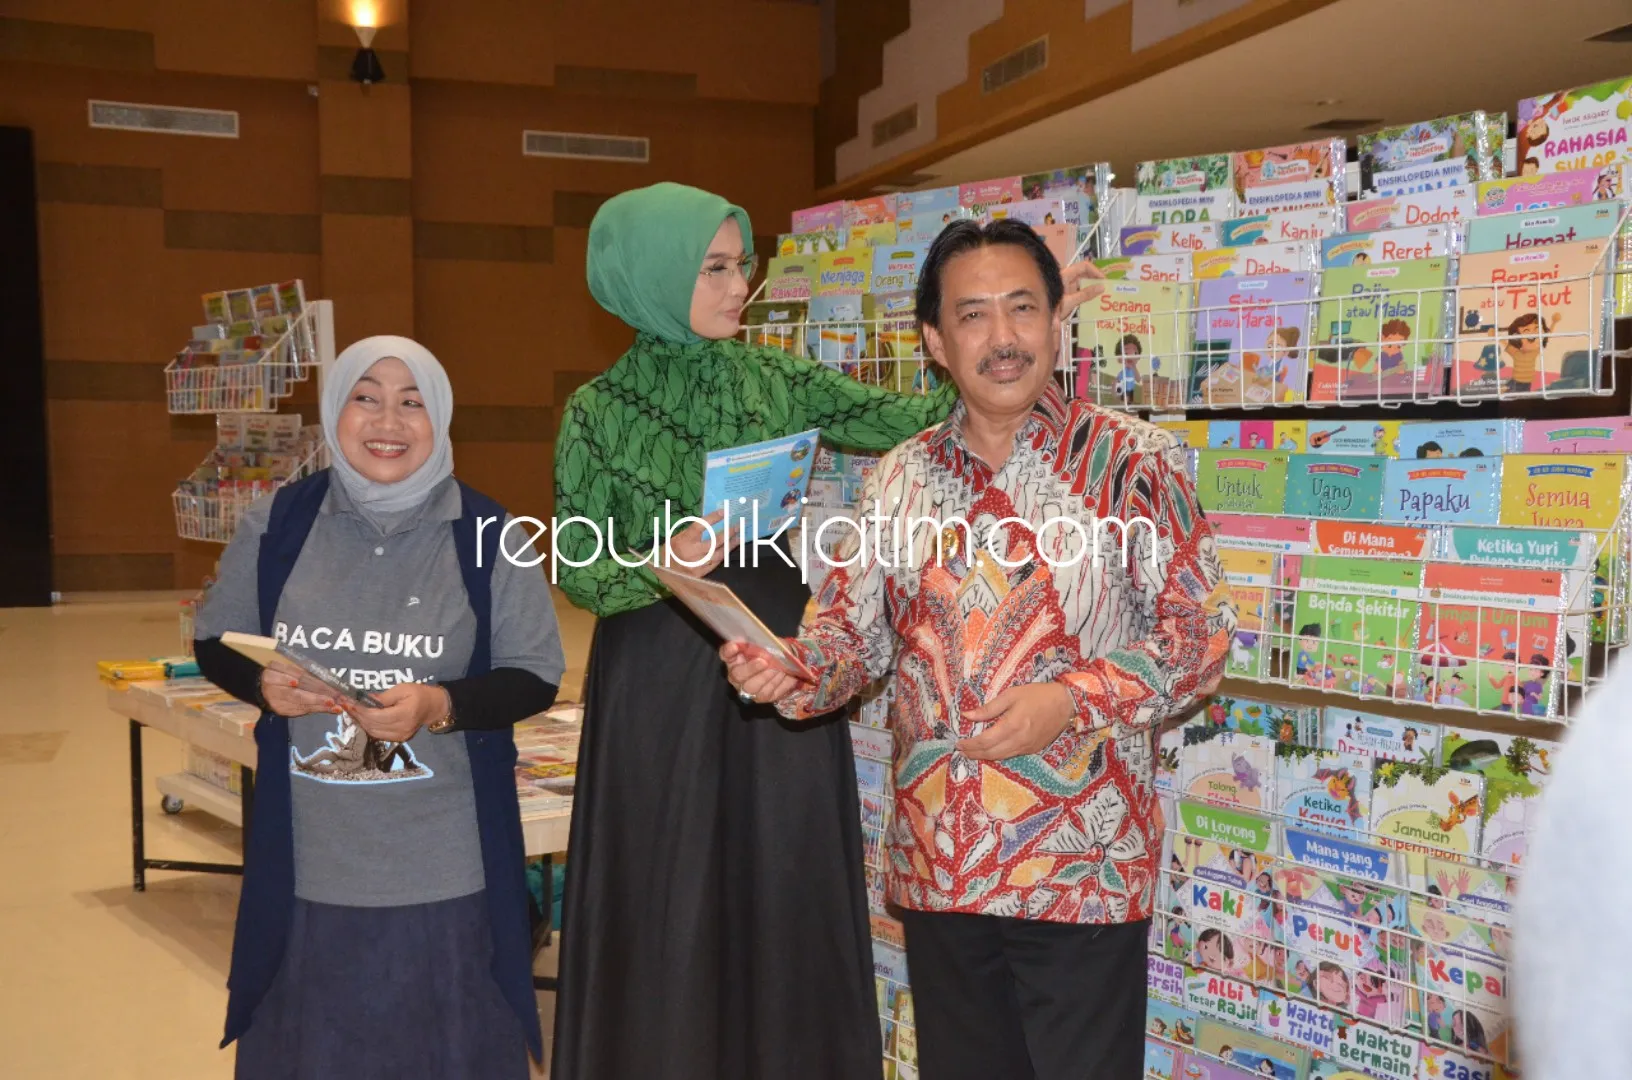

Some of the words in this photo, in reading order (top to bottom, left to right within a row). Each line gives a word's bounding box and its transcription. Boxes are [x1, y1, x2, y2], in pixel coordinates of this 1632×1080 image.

[1543, 127, 1628, 159] RAHASIA
[1377, 169, 1440, 187] ENSIKLOPEDIA
[1442, 164, 1463, 175] MINI
[1382, 240, 1433, 260] Reret
[1346, 307, 1372, 319] atau
[1216, 473, 1263, 499] Untuk
[1311, 477, 1353, 511] Uang
[1525, 482, 1591, 509] Semua
[1399, 484, 1471, 519] Papaku
[1343, 530, 1357, 545] Di
[1358, 532, 1395, 549] Mana
[1477, 538, 1524, 555] Ketika
[1527, 539, 1559, 557] Yuri
[1308, 593, 1353, 613] Benda
[1355, 597, 1410, 619] Sekitar
[1427, 601, 1488, 625] Tempat
[1490, 606, 1549, 629] Umum
[275, 621, 357, 652] BACA
[362, 630, 445, 658] BUKU
[1303, 794, 1342, 814] Ketika
[1195, 814, 1209, 830] Di
[1210, 819, 1257, 844] Lorong
[1392, 820, 1451, 845] Jamuan
[1306, 839, 1341, 859] Mana
[1341, 850, 1373, 869] yang
[1192, 884, 1246, 919] Kaki
[1292, 914, 1363, 957] Perut
[1189, 992, 1216, 1008] Tetap
[1207, 977, 1245, 1002] Albi
[1287, 1020, 1334, 1048] Tidur
[1355, 1028, 1413, 1059] Waktu
[1339, 1042, 1411, 1077] Bermain
